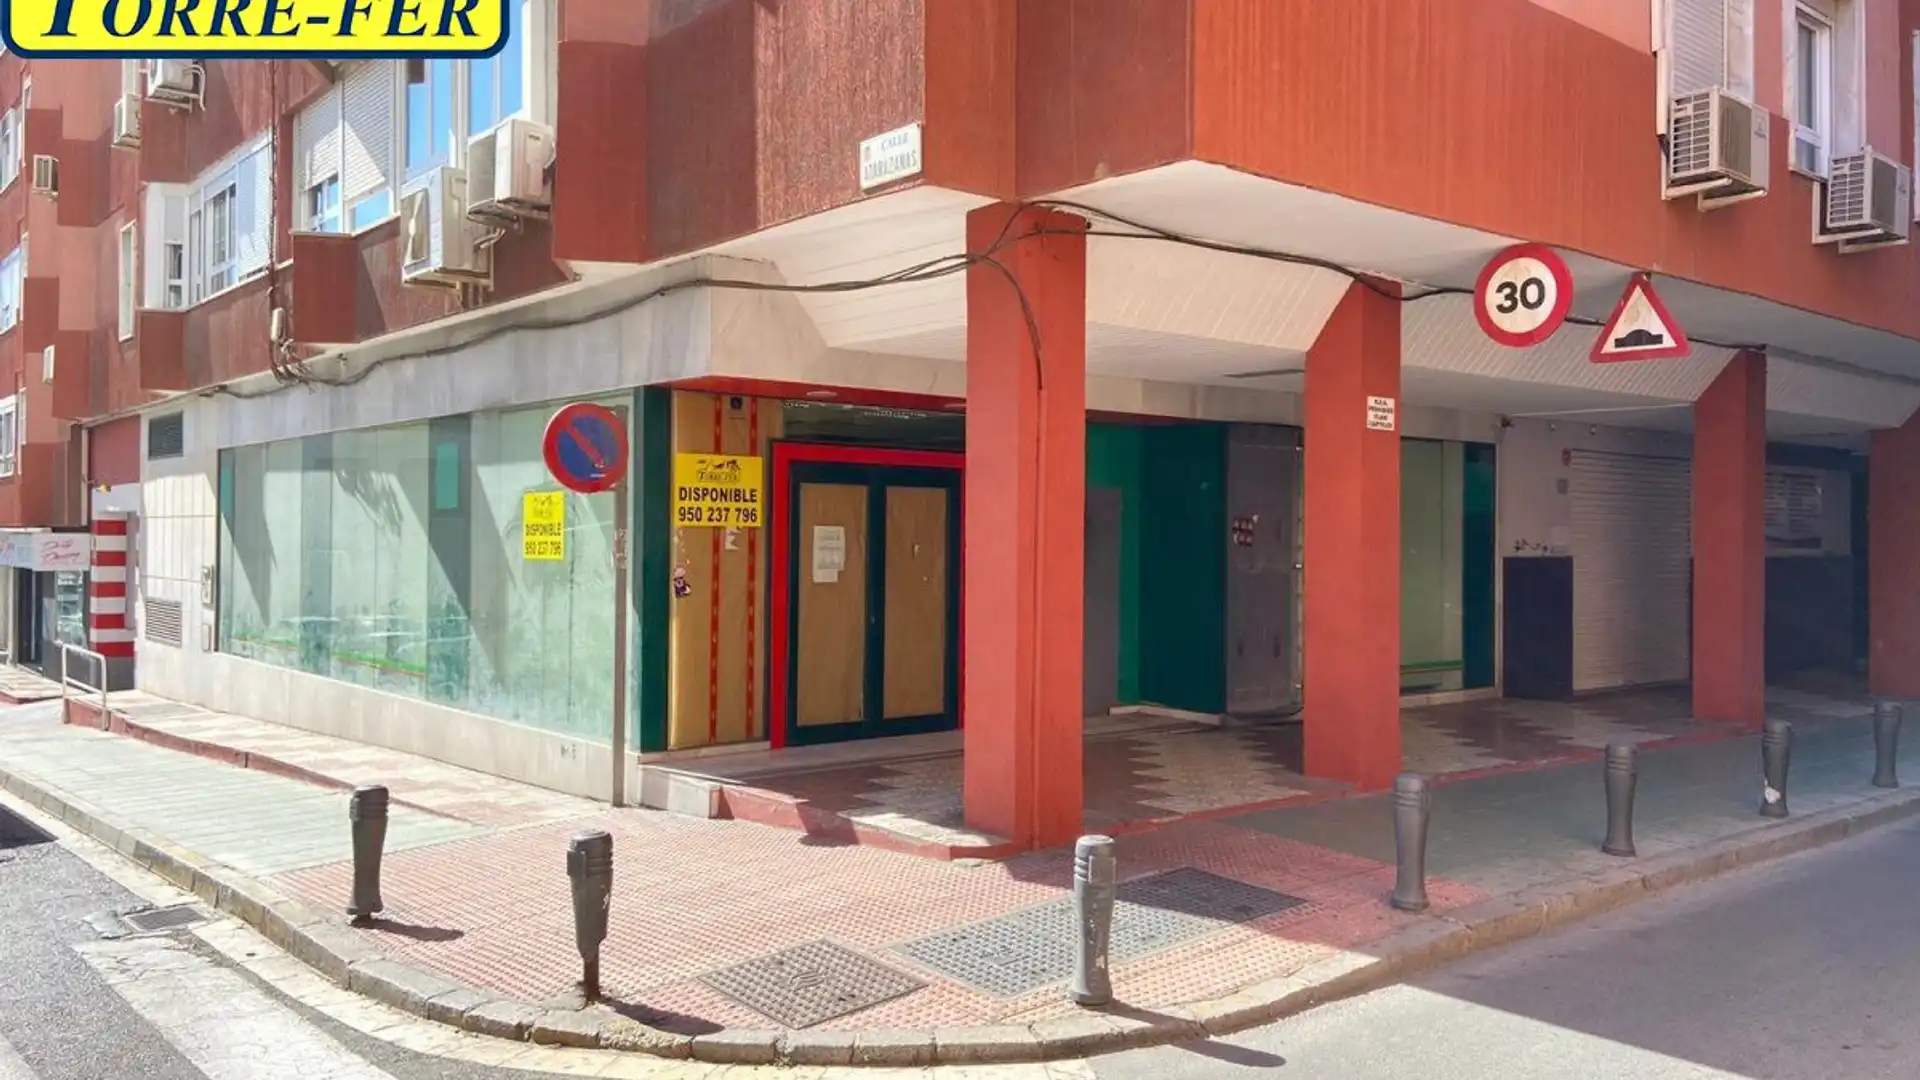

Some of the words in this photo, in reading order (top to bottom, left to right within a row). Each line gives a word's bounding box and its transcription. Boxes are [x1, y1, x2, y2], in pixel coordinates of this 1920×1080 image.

[881, 132, 909, 152] CALLE
[1495, 276, 1545, 314] 30
[679, 486, 758, 503] DISPONIBLE
[678, 506, 703, 522] 950
[707, 506, 731, 523] 237
[734, 507, 758, 523] 796
[525, 522, 562, 536] DISPONIBLE
